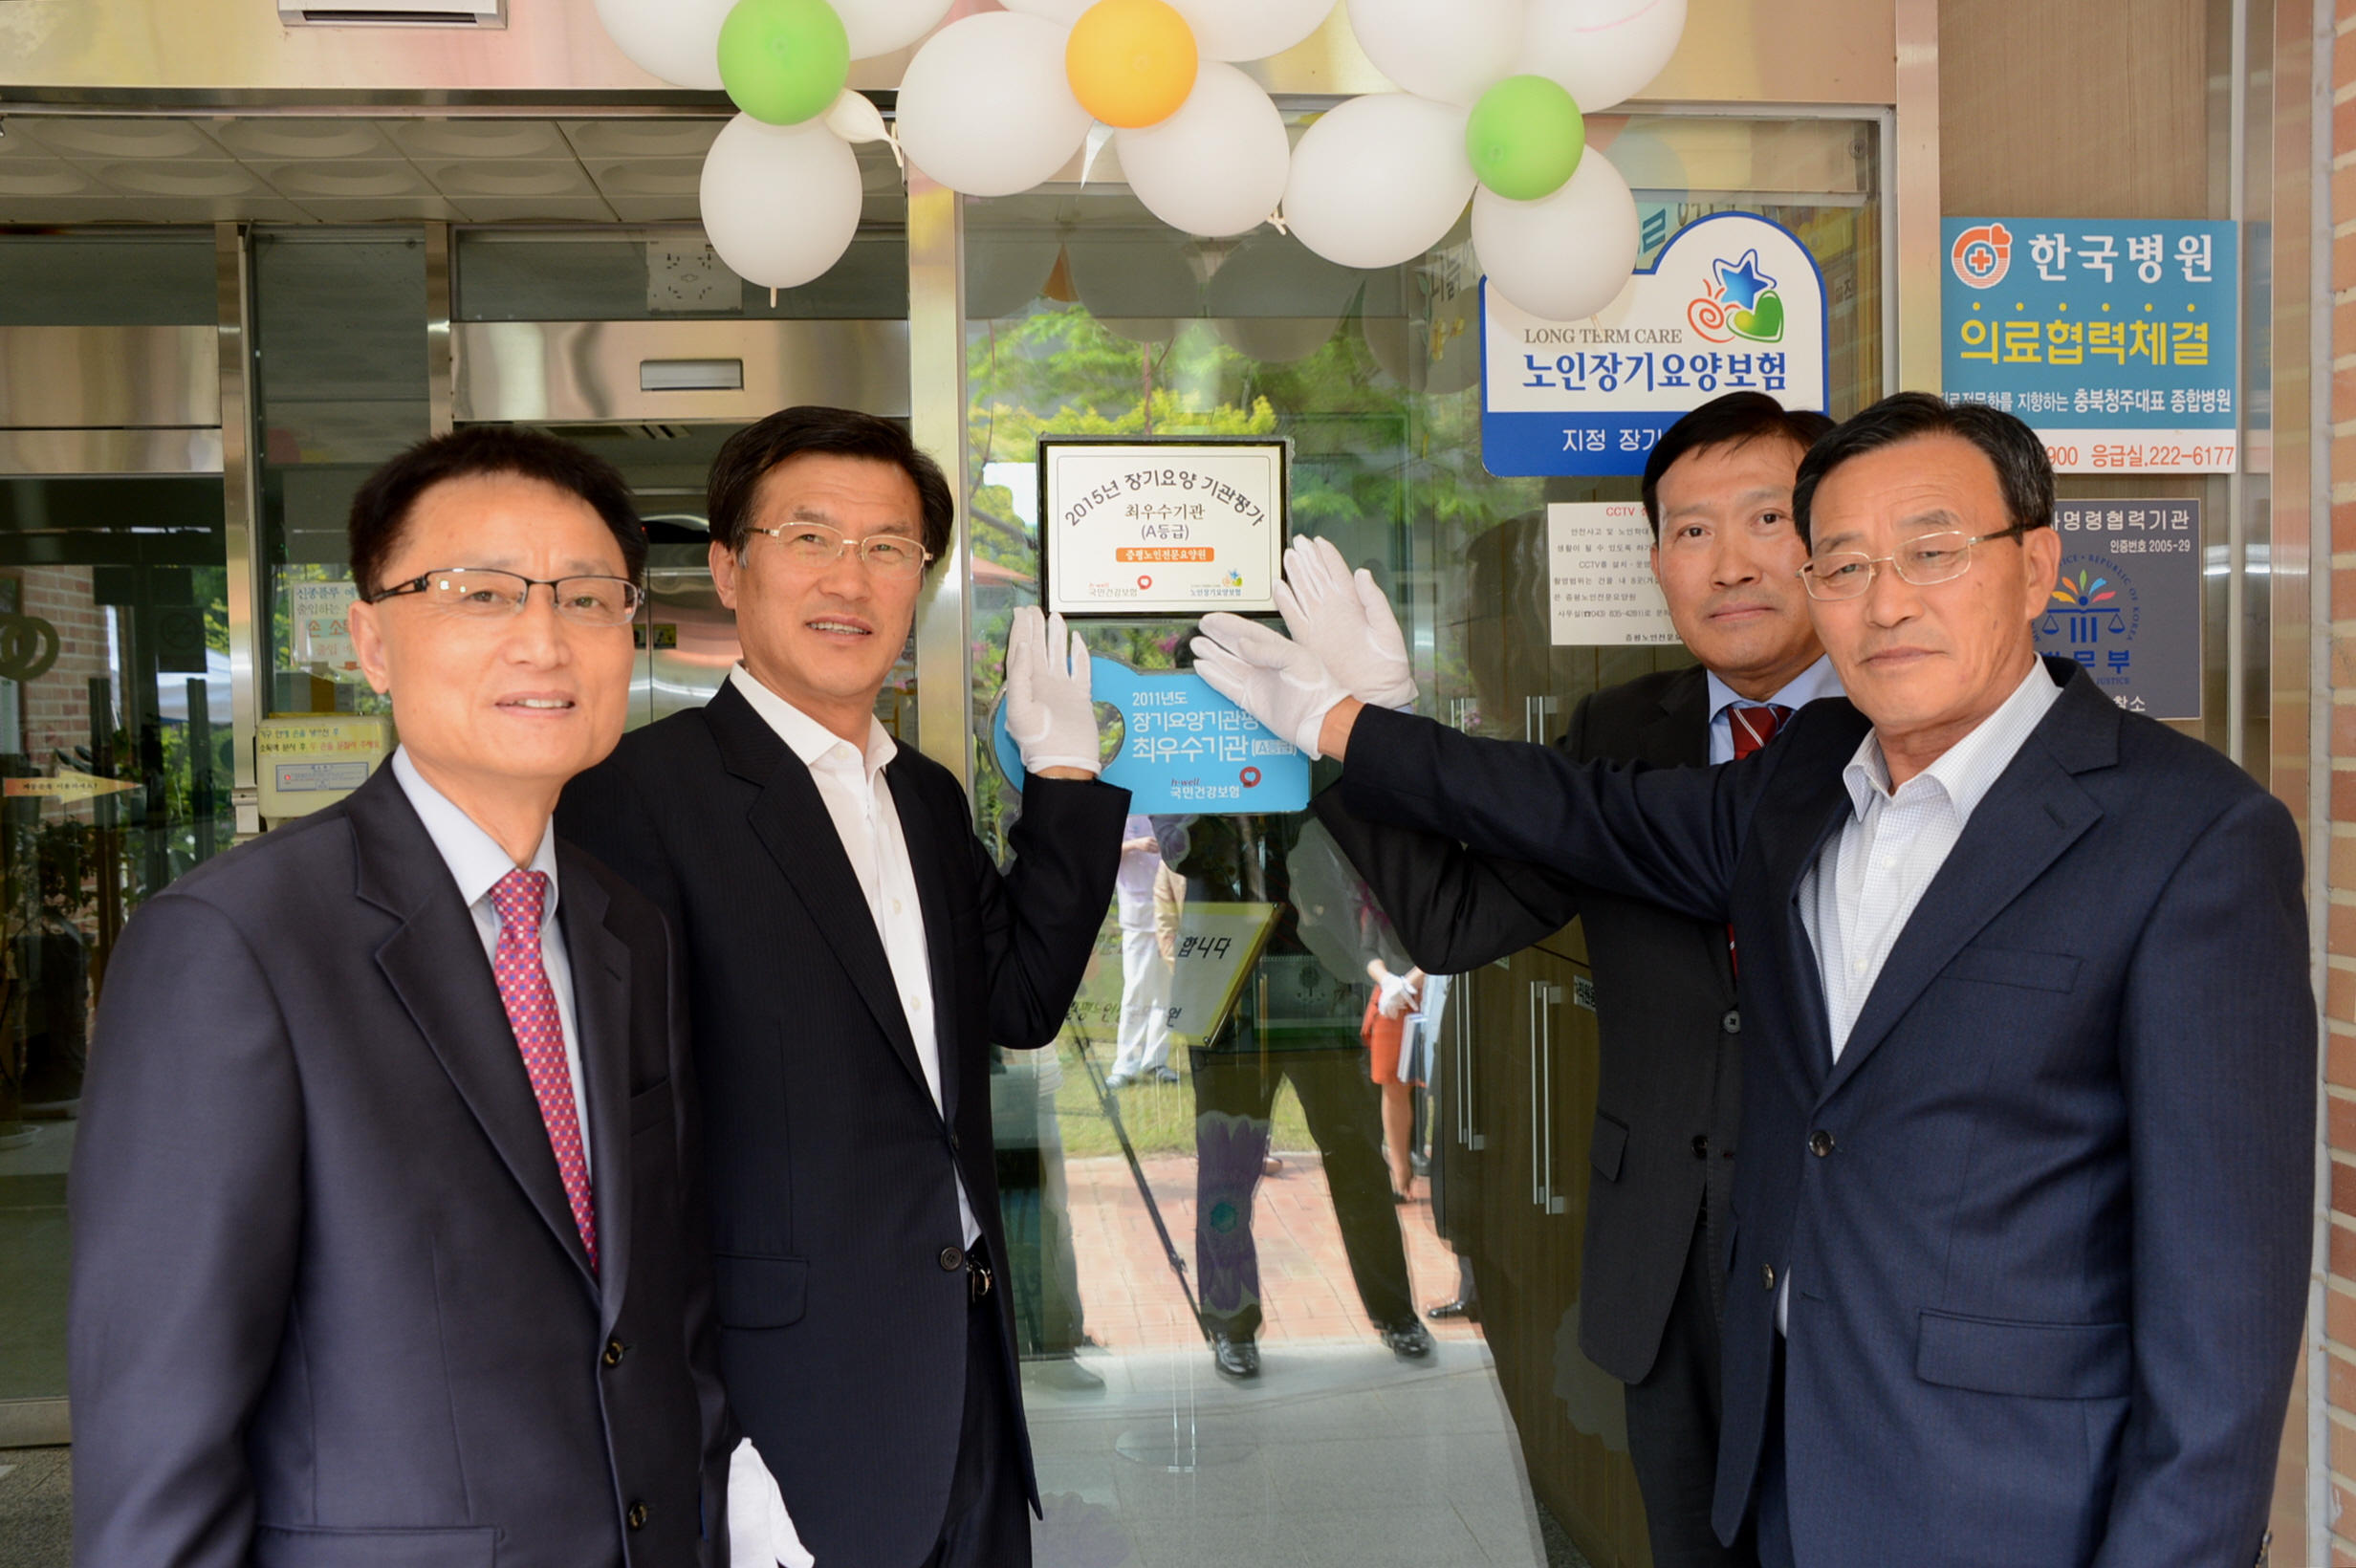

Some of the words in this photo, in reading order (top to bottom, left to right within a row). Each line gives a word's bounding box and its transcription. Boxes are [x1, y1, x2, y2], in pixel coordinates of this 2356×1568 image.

[2028, 232, 2212, 284] 한국병원
[1524, 329, 1575, 344] LONG
[1579, 328, 1631, 344] TERM
[1634, 328, 1683, 344] CARE
[1960, 319, 2209, 365] 의료협력체결
[1522, 352, 1786, 392] 노인장기요양보험
[2018, 391, 2068, 412] 지향하는
[2073, 388, 2166, 413] 충북청주대표
[2171, 388, 2231, 414] 종합병원
[1562, 429, 1606, 451] 지정
[1619, 427, 1662, 452] 장기
[2047, 446, 2079, 466] 900
[1064, 479, 1122, 527] 2015년
[1124, 468, 1197, 491] 장기요양
[1201, 475, 1266, 527] 기관평가
[1124, 503, 1206, 521] 최우수기관
[1606, 507, 1635, 516] CCTV
[1141, 524, 1189, 540] (A등급)
[1571, 528, 1602, 536] 안전사고
[1557, 544, 1580, 553] 생활이
[2110, 539, 2147, 554] 인증번호
[2149, 539, 2191, 553] 2005-29
[1125, 549, 1207, 562] 증평노인전문요양원
[1579, 560, 1607, 569] CCTV를
[1612, 560, 1627, 569] 설치
[1598, 577, 1613, 585] 건물
[1088, 588, 1138, 599] 국민건강보험
[1190, 588, 1242, 598] 노인장기요양보험
[2088, 555, 2132, 585] REPUBLIC
[2126, 607, 2140, 641] KOREA
[308, 620, 321, 638] 손
[2096, 677, 2130, 686] JUSTICE
[1132, 691, 1188, 706] 2011년도
[1132, 710, 1259, 732] 장기요양기관평
[1132, 735, 1249, 763] 최우수기관
[1252, 739, 1298, 756] (A등급)
[1170, 786, 1240, 799] 국민건강보험
